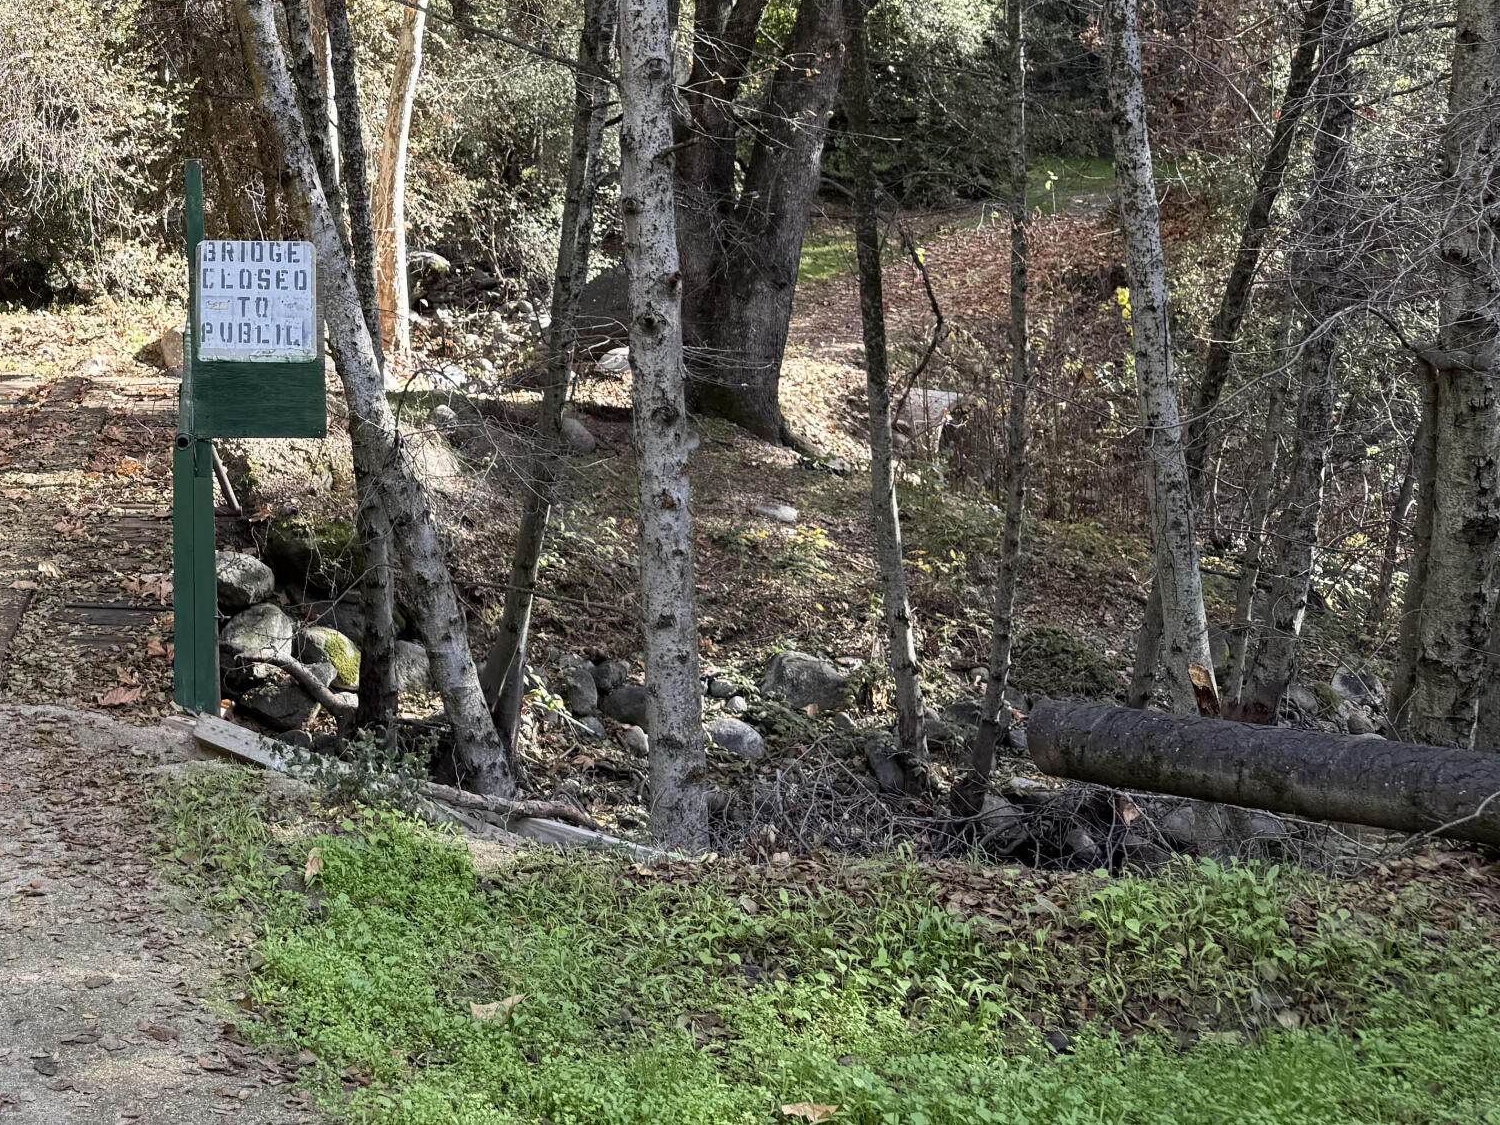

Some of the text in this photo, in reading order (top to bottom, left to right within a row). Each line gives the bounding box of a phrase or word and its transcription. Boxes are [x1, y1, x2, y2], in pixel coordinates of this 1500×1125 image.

[203, 242, 301, 263] BRIDGE
[202, 268, 307, 291] CLOSED
[237, 296, 269, 318] TO
[201, 322, 300, 346] PUBLIC
